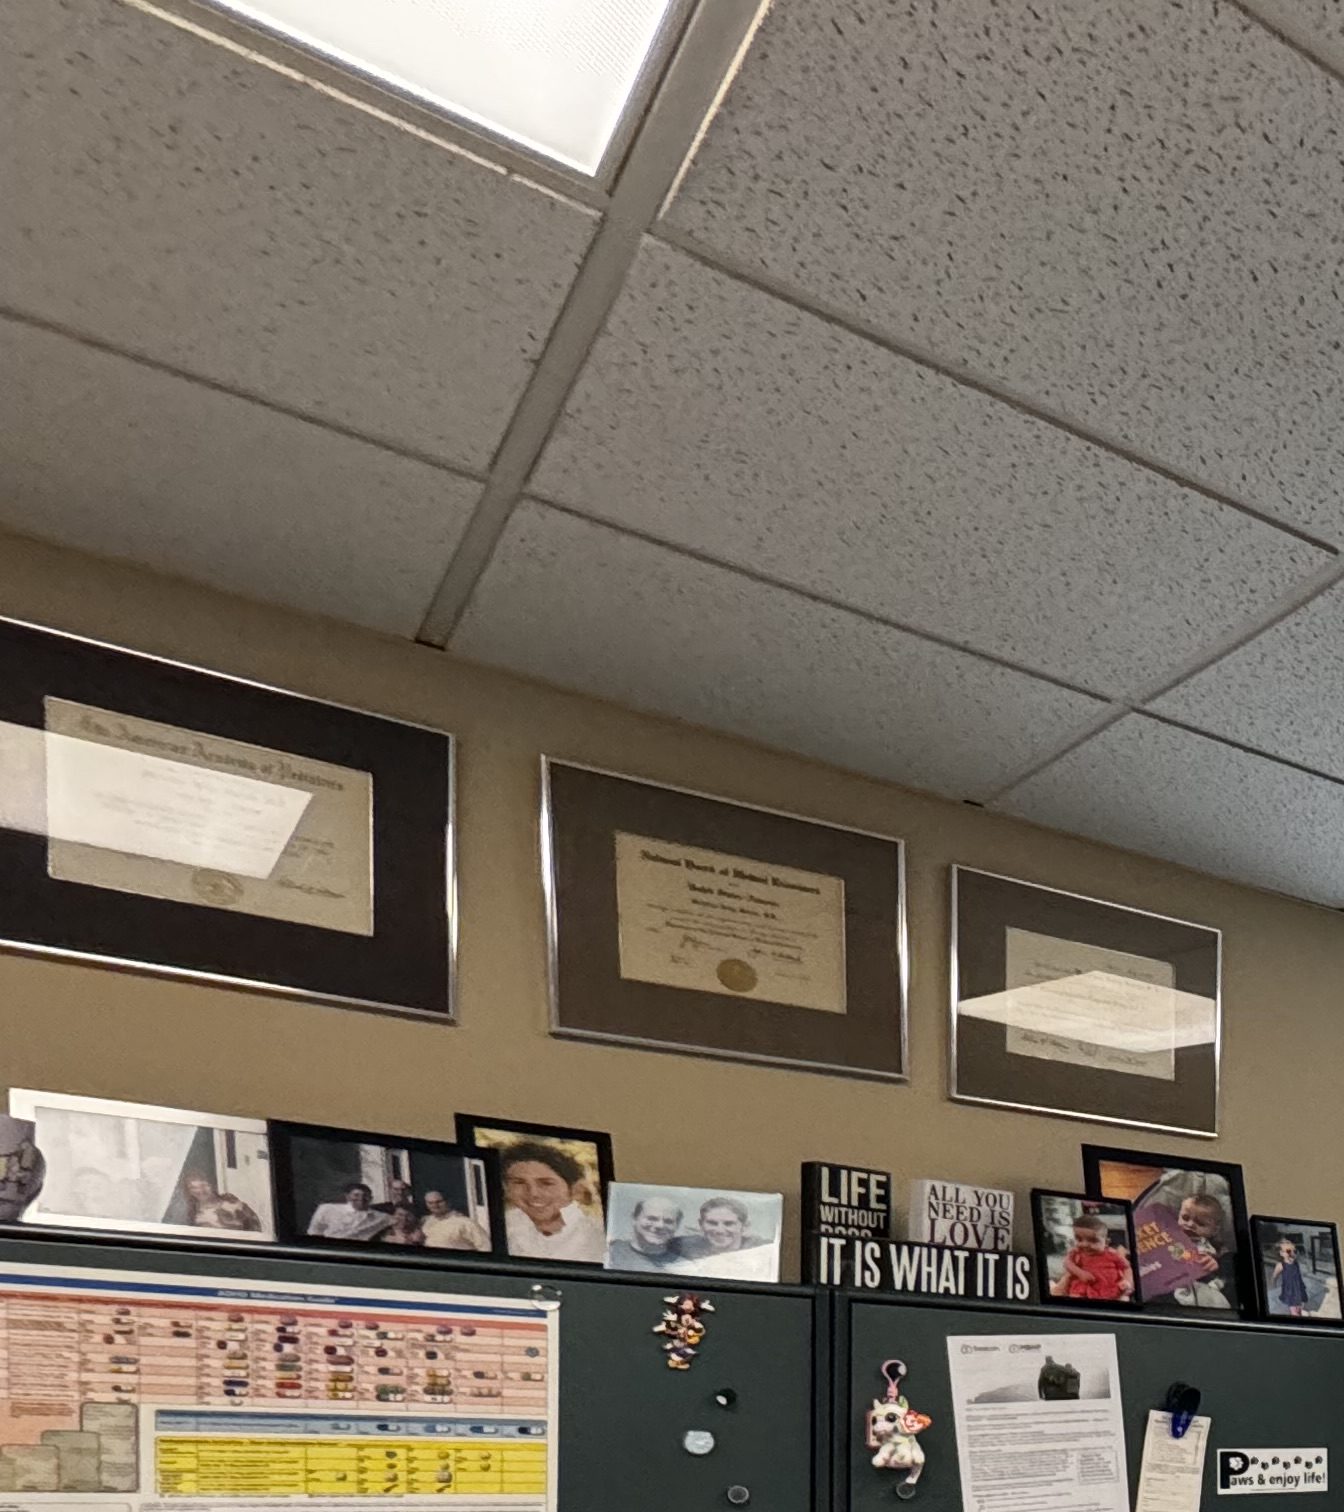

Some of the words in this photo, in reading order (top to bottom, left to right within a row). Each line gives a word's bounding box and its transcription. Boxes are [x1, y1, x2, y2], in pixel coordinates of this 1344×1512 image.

[820, 1166, 888, 1210] LIFE
[928, 1183, 966, 1204] ALL
[974, 1190, 1011, 1210] YOU
[820, 1204, 887, 1229] WITHOUT
[928, 1201, 982, 1222] NEED
[990, 1208, 1011, 1227] IS
[929, 1218, 1010, 1250] LOVE
[820, 1236, 847, 1285] IT
[854, 1240, 881, 1288] IS
[889, 1243, 969, 1295] WHAT
[977, 1252, 1000, 1298] IT
[1007, 1254, 1030, 1300] IS
[1257, 1473, 1266, 1485] &
[1269, 1472, 1301, 1487] enjoy
[1303, 1472, 1326, 1484] life!
